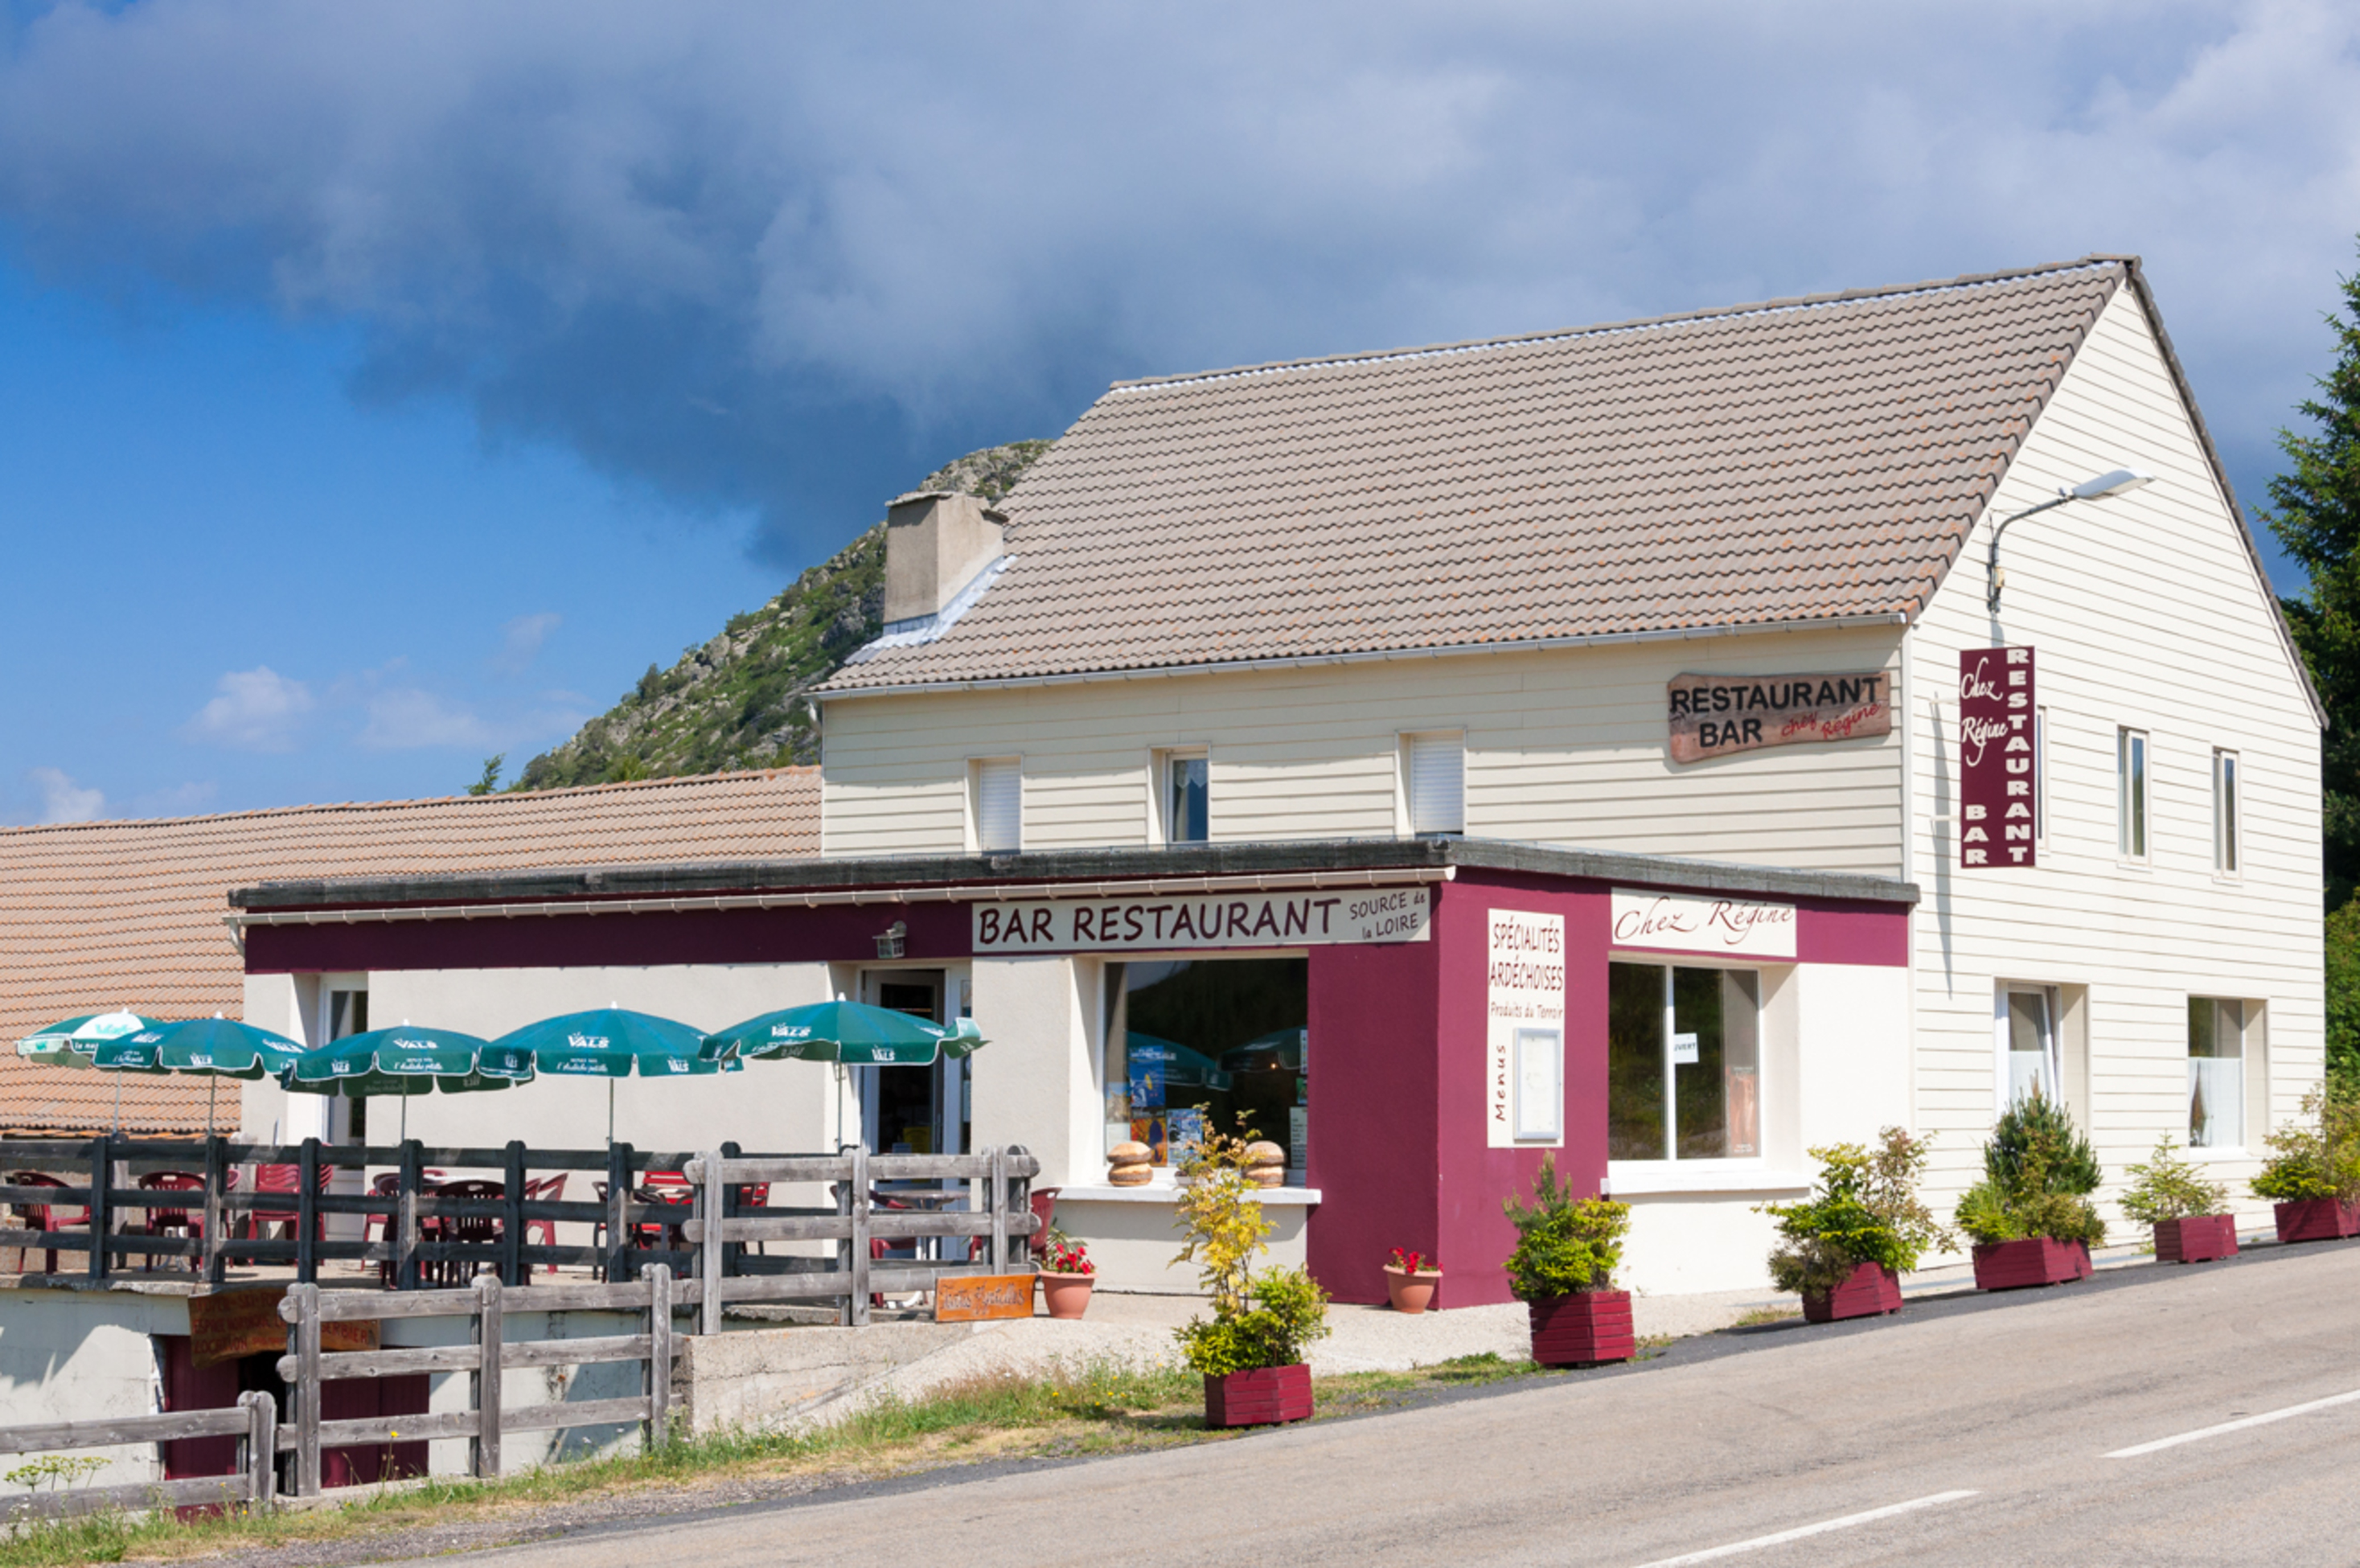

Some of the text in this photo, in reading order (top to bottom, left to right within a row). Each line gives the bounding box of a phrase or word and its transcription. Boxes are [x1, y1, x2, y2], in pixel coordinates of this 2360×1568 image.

[1669, 677, 1882, 713] RESTAURANT
[1960, 657, 2003, 701] Chez
[1699, 719, 1763, 748] BAR
[1820, 704, 1881, 739] Régine
[1962, 716, 2009, 767] Régine
[2005, 649, 2031, 863] RESTAURANT
[1963, 804, 1989, 864] BAR
[979, 898, 1341, 944] BAR RESTAURANT
[1349, 891, 1426, 920] SOURCE de
[1615, 896, 1793, 945] Chez Régine
[1362, 913, 1418, 940] la LOIRE
[1493, 915, 1559, 953] SPÉCIALITÉS
[1489, 954, 1563, 991] ARDÉCHOISES
[1491, 1001, 1562, 1019] Produits du Terroir
[393, 1038, 437, 1049] VALS
[568, 1034, 609, 1049] VALS
[872, 1047, 895, 1061] VALS
[667, 1057, 689, 1072] VALS
[1495, 1045, 1506, 1122] Menus
